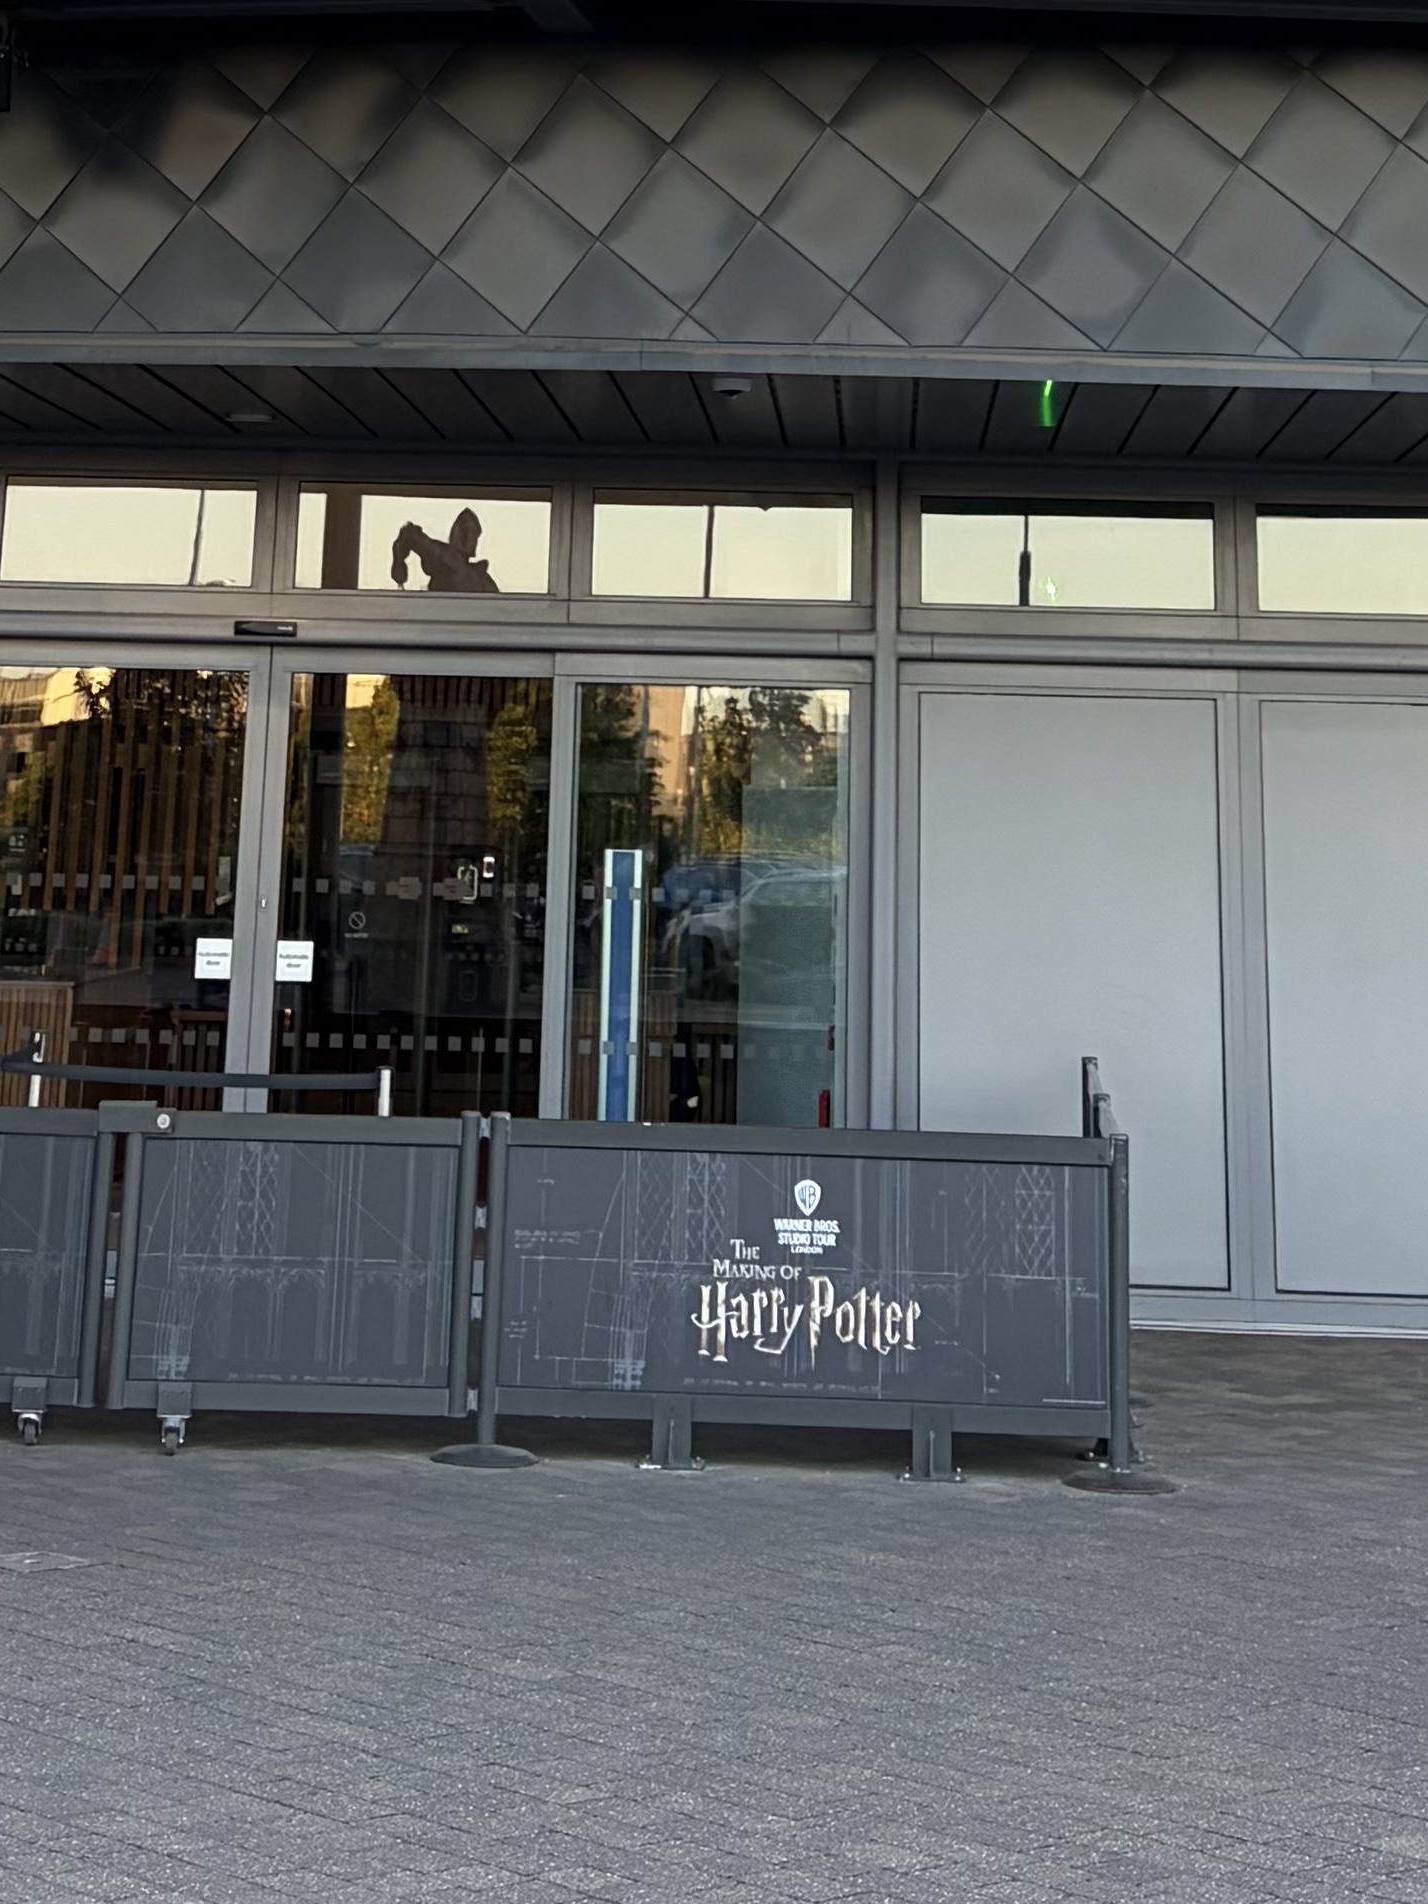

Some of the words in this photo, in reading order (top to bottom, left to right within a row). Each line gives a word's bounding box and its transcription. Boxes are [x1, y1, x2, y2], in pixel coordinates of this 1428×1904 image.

[777, 1232, 811, 1245] STUDIO
[812, 1233, 837, 1247] TOUR
[690, 1281, 804, 1362] Harry
[807, 1275, 922, 1372] Potter
